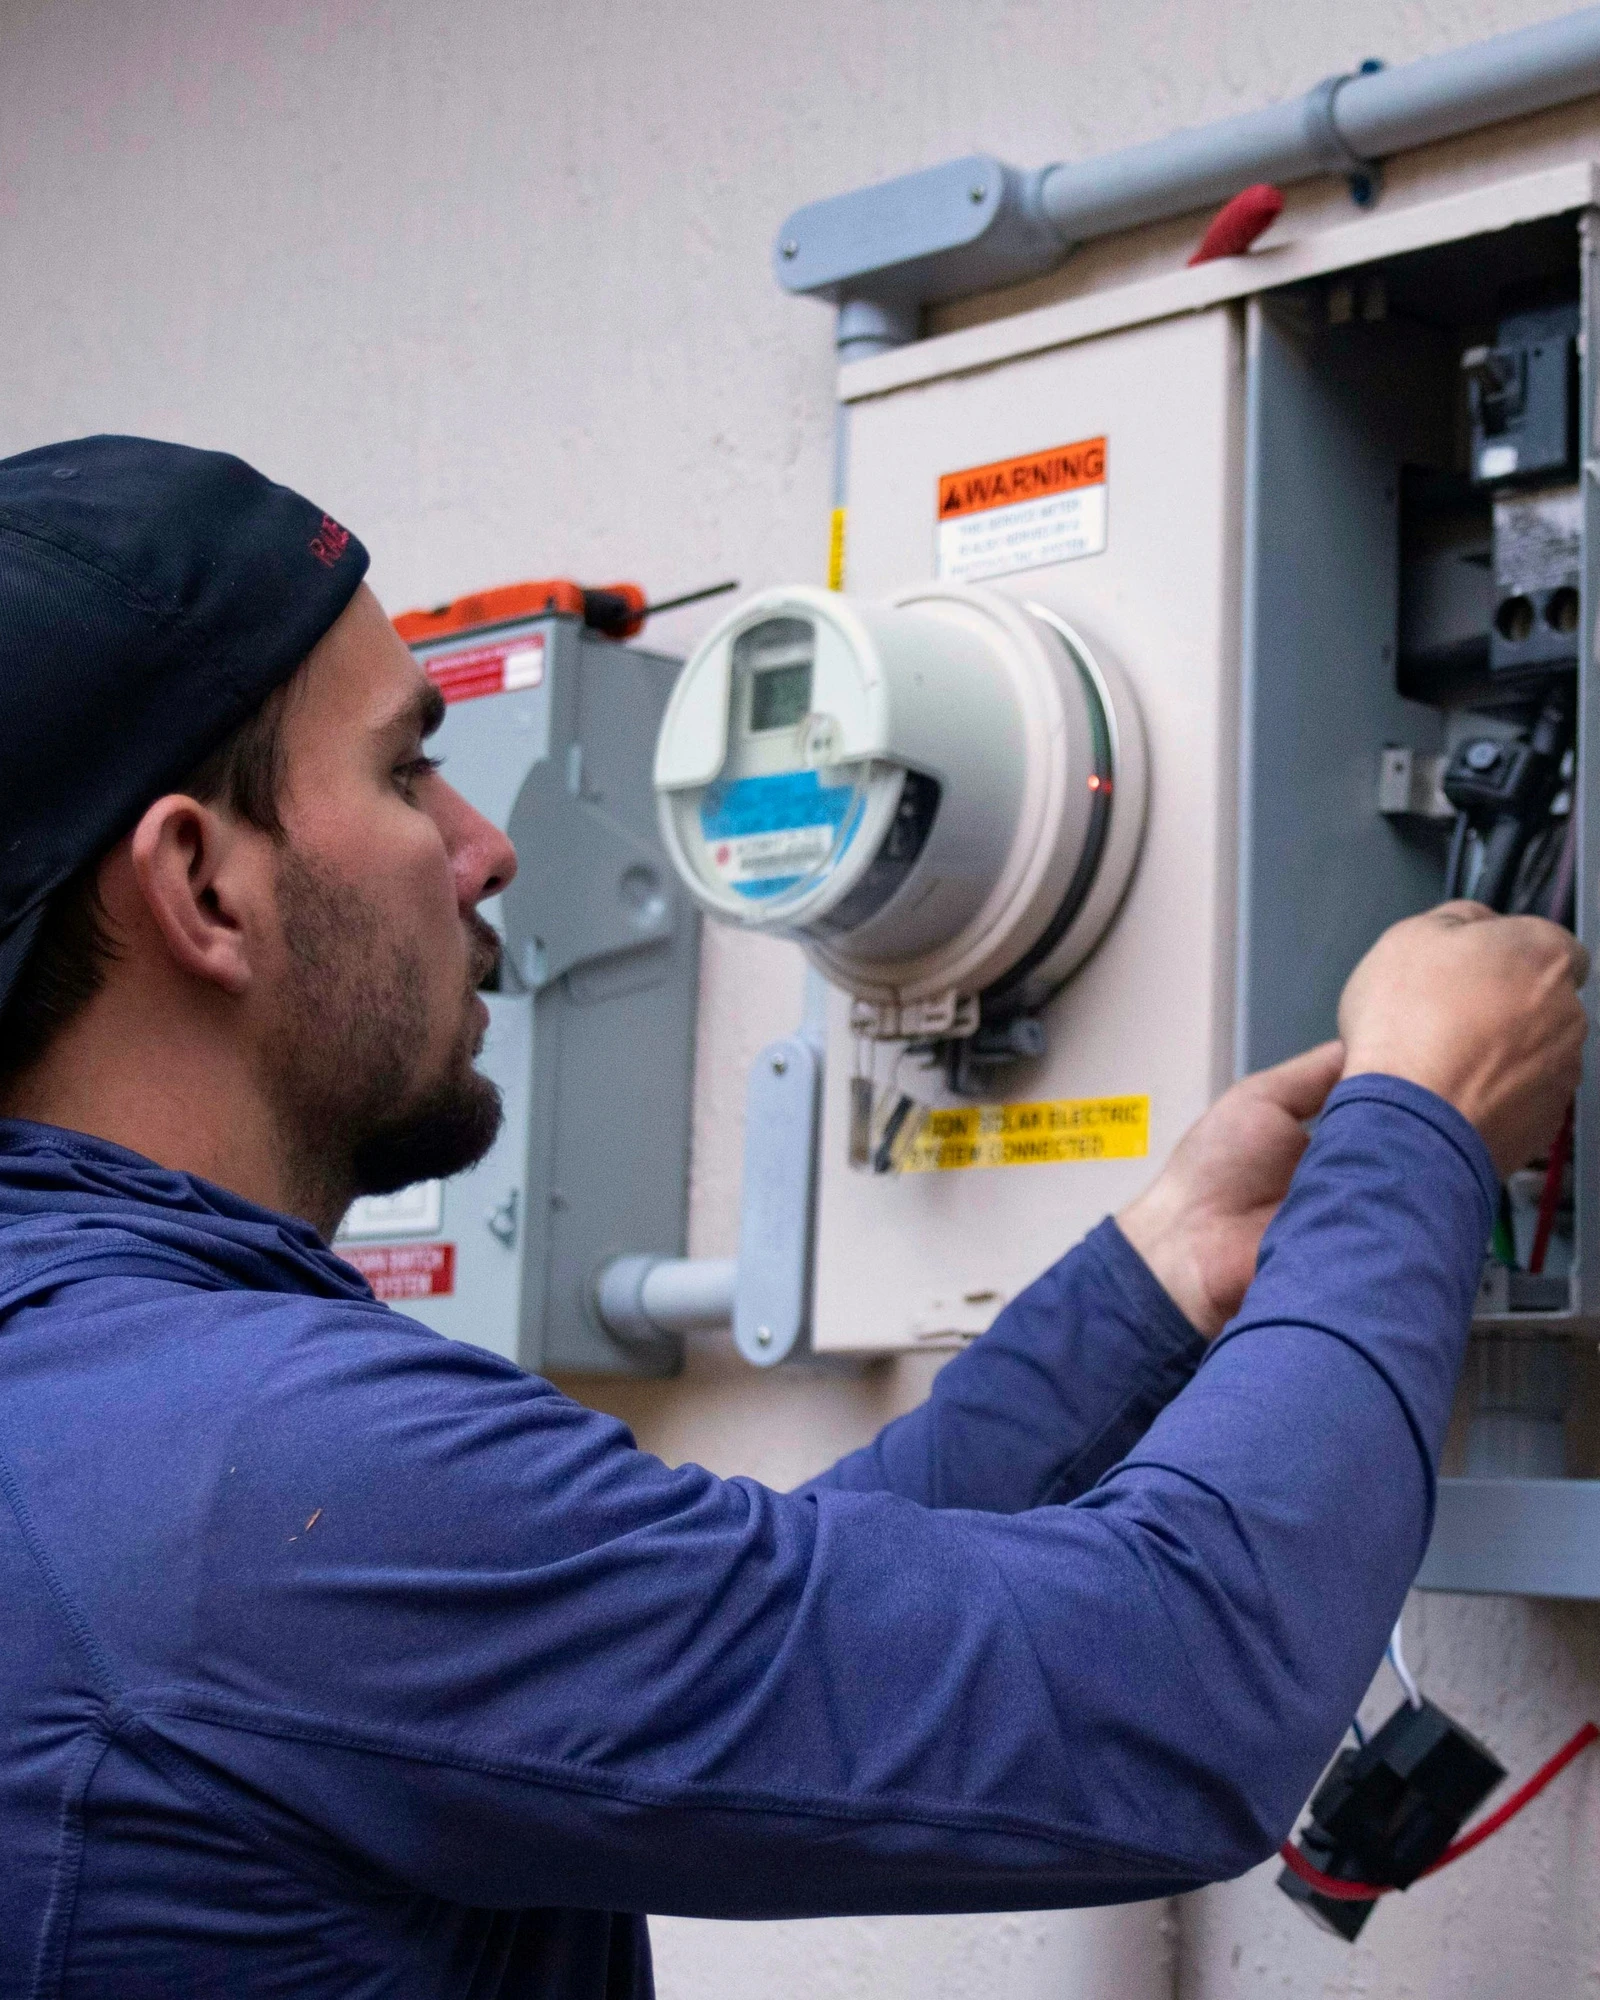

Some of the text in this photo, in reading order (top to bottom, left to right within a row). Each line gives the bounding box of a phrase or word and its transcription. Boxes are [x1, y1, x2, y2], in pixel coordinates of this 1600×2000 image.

[966, 448, 1105, 504] WARNING
[1048, 1101, 1143, 1129] ELECTRIC
[987, 1135, 1105, 1164] CONNECTED
